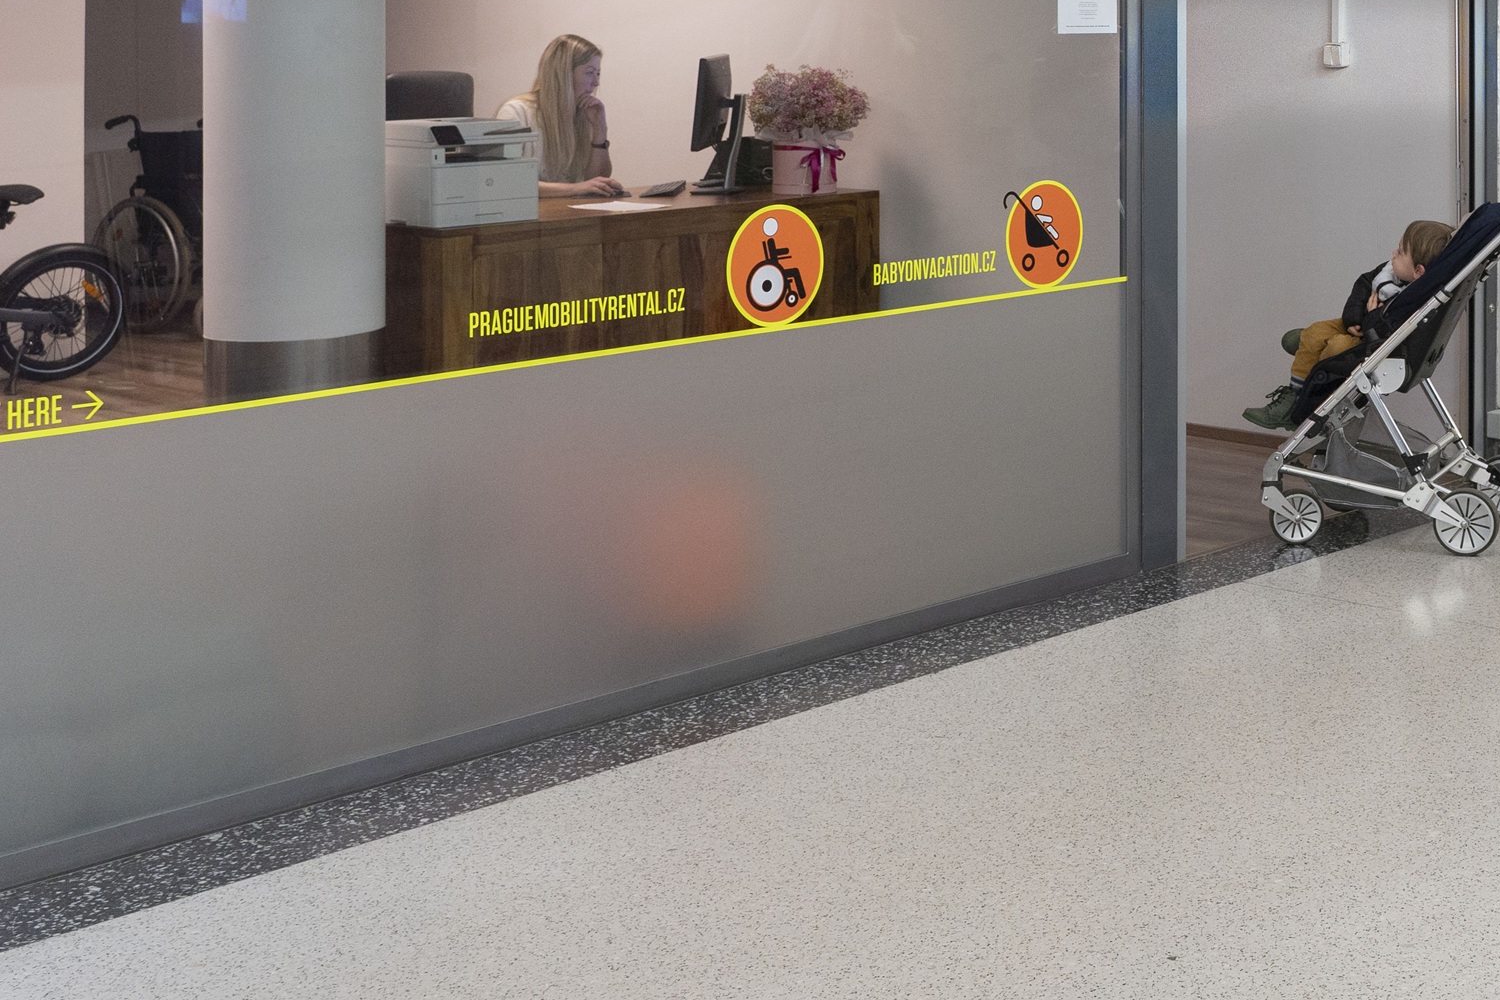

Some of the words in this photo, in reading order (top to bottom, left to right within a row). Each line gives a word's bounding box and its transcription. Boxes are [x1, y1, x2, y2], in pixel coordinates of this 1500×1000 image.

[873, 250, 997, 286] BABYONVACATION.CZ
[469, 288, 686, 338] PRAGUEMOBILITYRENTAL.CZ
[7, 395, 62, 430] HERE
